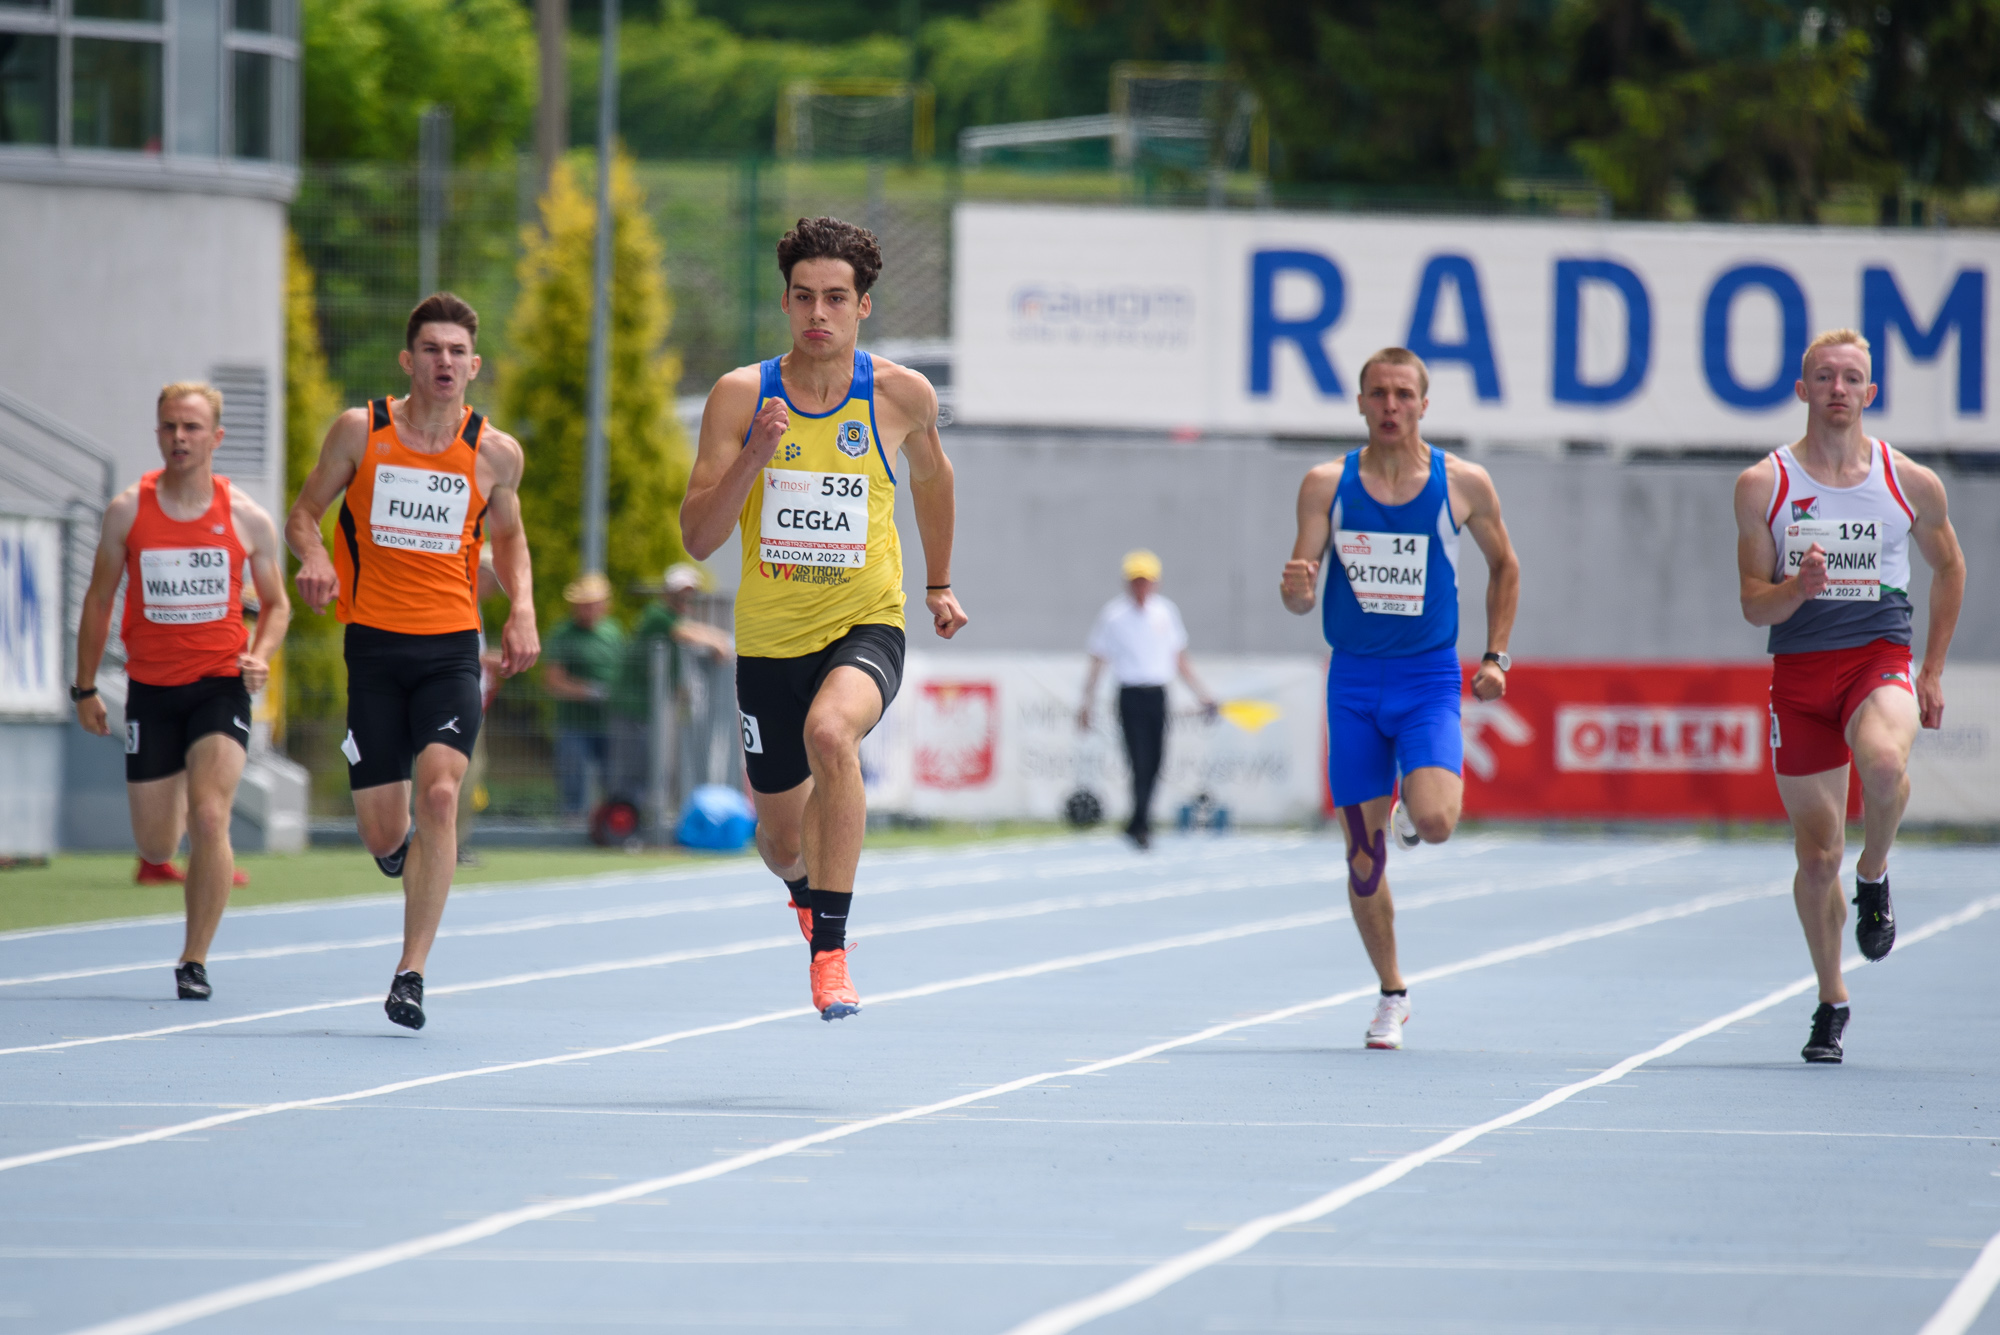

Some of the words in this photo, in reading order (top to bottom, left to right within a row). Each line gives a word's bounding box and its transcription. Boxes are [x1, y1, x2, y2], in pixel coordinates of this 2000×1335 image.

[1248, 248, 1986, 418] RADOM
[850, 430, 858, 439] S
[427, 474, 465, 495] 309
[780, 480, 811, 491] mosir
[821, 476, 863, 498] 536
[388, 499, 451, 524] FUJAK
[777, 508, 851, 532] CEGŁA
[1838, 523, 1877, 540] 194
[376, 534, 416, 547] RADOM
[419, 540, 443, 550] 2022
[1392, 537, 1416, 555] 14
[188, 552, 224, 568] 303
[766, 548, 813, 561] RADOM
[817, 552, 846, 563] 2022
[1789, 550, 1877, 570] SZPANIAK
[1346, 562, 1423, 585] ÓŁTORAK
[146, 579, 226, 597] WAŁASZEK
[1835, 588, 1861, 597] 2022
[743, 716, 755, 749] 6
[1571, 720, 1747, 760] ORLEN
